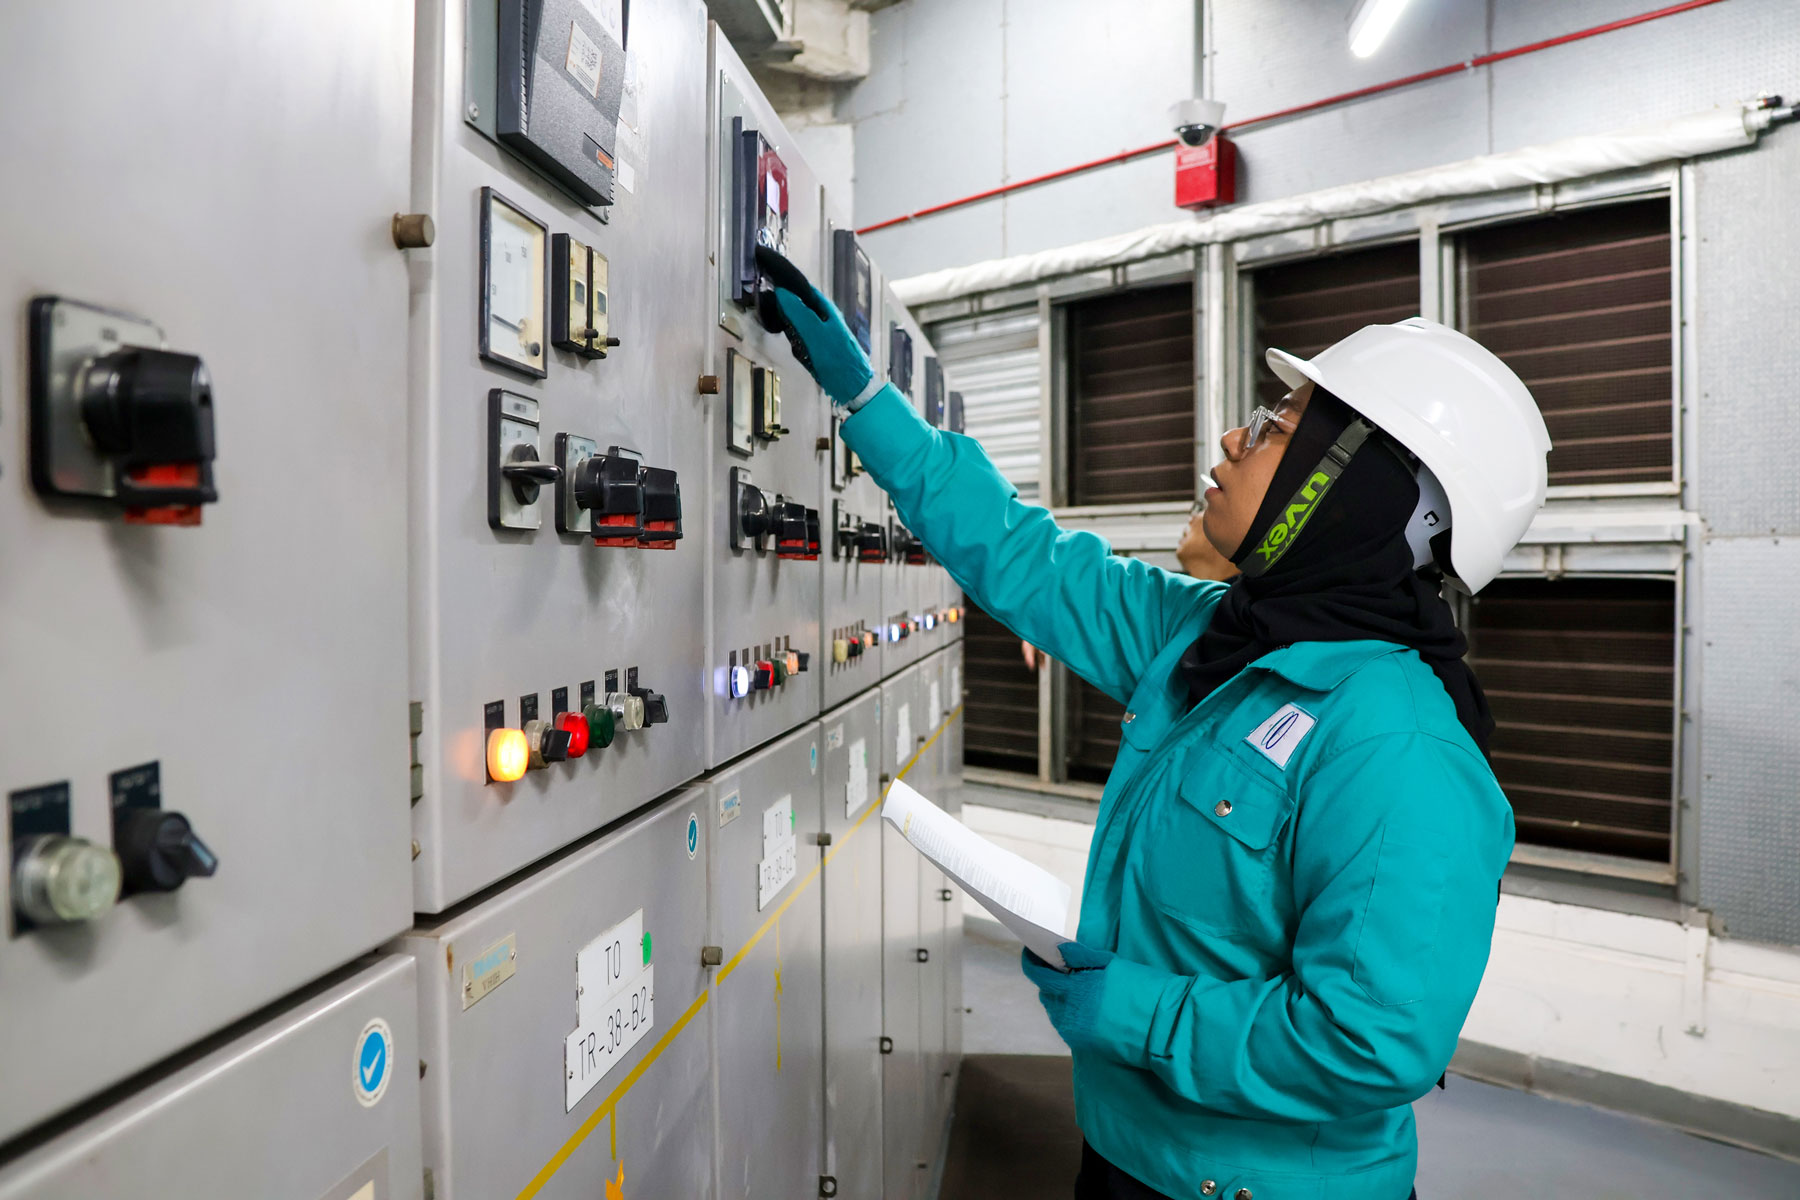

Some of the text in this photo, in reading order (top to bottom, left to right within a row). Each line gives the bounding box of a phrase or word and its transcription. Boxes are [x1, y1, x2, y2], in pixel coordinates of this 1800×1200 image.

[1256, 471, 1330, 561] uvex
[605, 940, 621, 986] TO
[578, 986, 647, 1081] TR-38-B2
